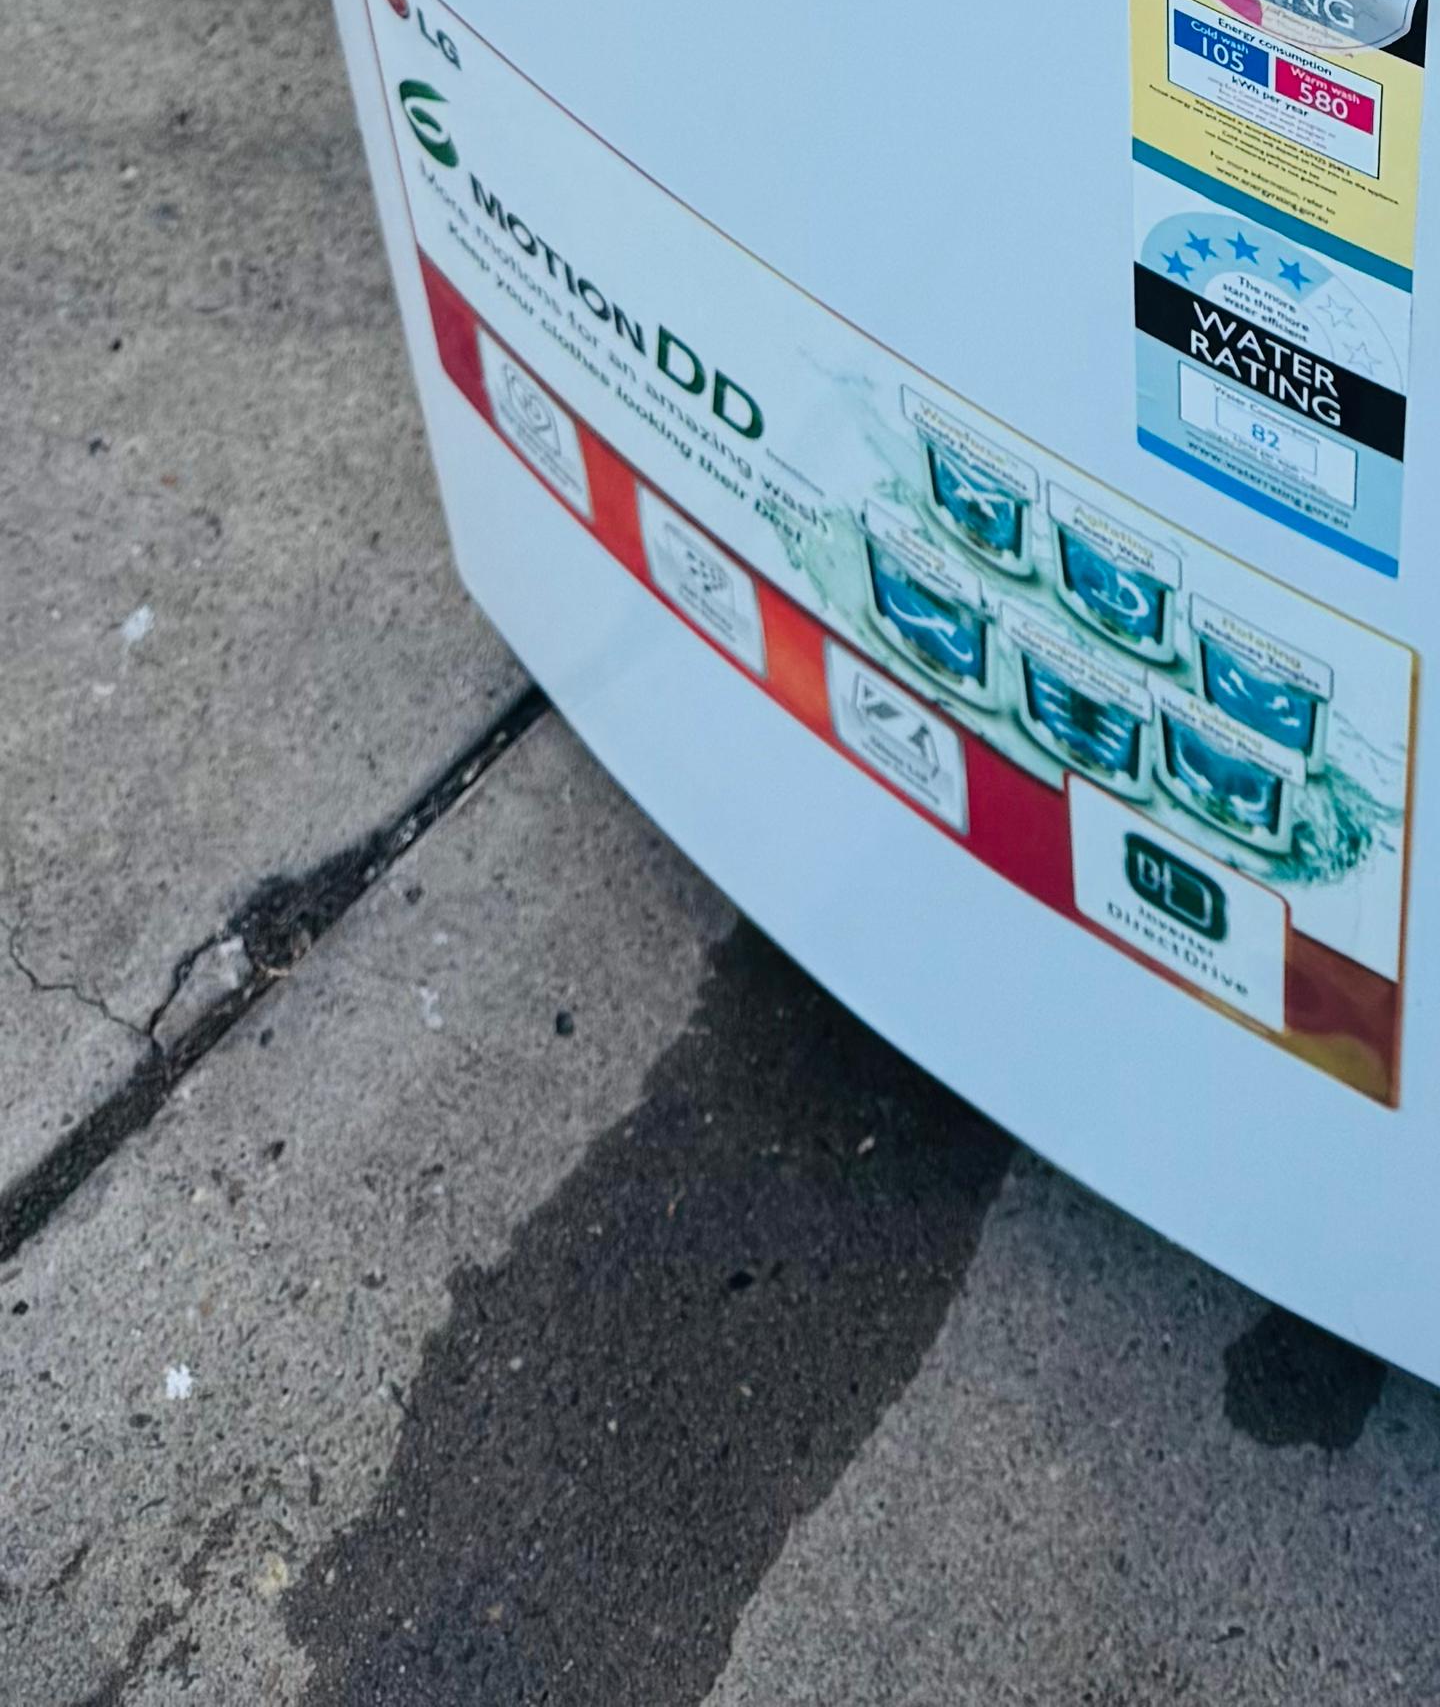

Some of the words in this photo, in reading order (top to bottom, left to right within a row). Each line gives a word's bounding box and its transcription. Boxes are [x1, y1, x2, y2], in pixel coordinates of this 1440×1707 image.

[416, 7, 462, 71] LG
[1190, 20, 1219, 40] Cold
[1221, 34, 1249, 54] wash
[1201, 36, 1244, 73] 105
[1217, 17, 1256, 42] Energy
[1258, 37, 1332, 76] consumption
[1231, 74, 1259, 97] kWh
[1262, 89, 1283, 106] per
[1284, 100, 1309, 118] year
[1290, 65, 1328, 90] Warm
[1330, 83, 1361, 105] wash
[1298, 83, 1348, 120] 580
[469, 171, 647, 357] MOTION
[657, 323, 766, 440] DD
[1222, 283, 1251, 303] stars
[1254, 294, 1275, 312] the
[1276, 306, 1310, 333] more
[1223, 295, 1257, 315] water
[1238, 275, 1260, 293] The
[1264, 287, 1297, 314] more
[1192, 301, 1339, 396] WATER
[1190, 329, 1341, 427] RATING
[540, 317, 611, 387] clothes
[615, 385, 692, 460] looking
[699, 450, 749, 501] their
[566, 310, 599, 348] for
[608, 350, 638, 384] an
[645, 382, 753, 480] amazing
[760, 473, 829, 534] wash
[1251, 423, 1281, 451] 82
